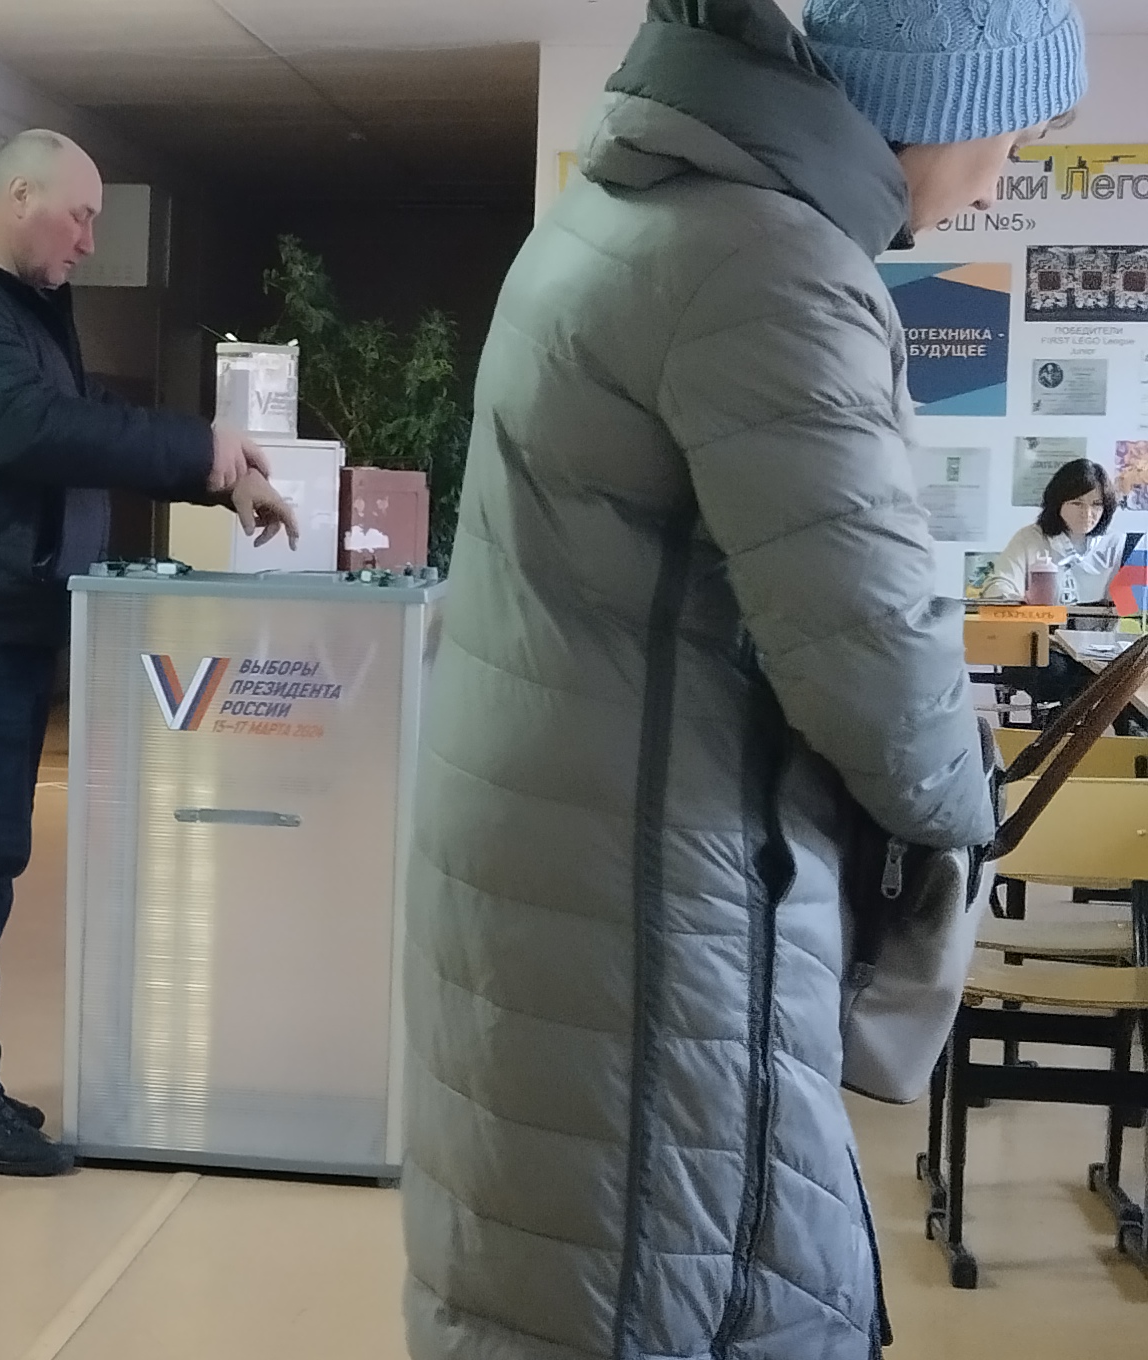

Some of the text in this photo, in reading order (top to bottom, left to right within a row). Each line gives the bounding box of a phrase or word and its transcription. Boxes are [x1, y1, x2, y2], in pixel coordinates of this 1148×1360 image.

[1072, 337, 1101, 345] LEGO
[910, 344, 987, 358] БУДУЩЕЕ
[239, 659, 321, 676] ВЫБОРЫ
[229, 680, 342, 700] ПРЕЗИДЕНТА
[219, 701, 292, 717] РОССИИ
[248, 721, 289, 736] МАРТА
